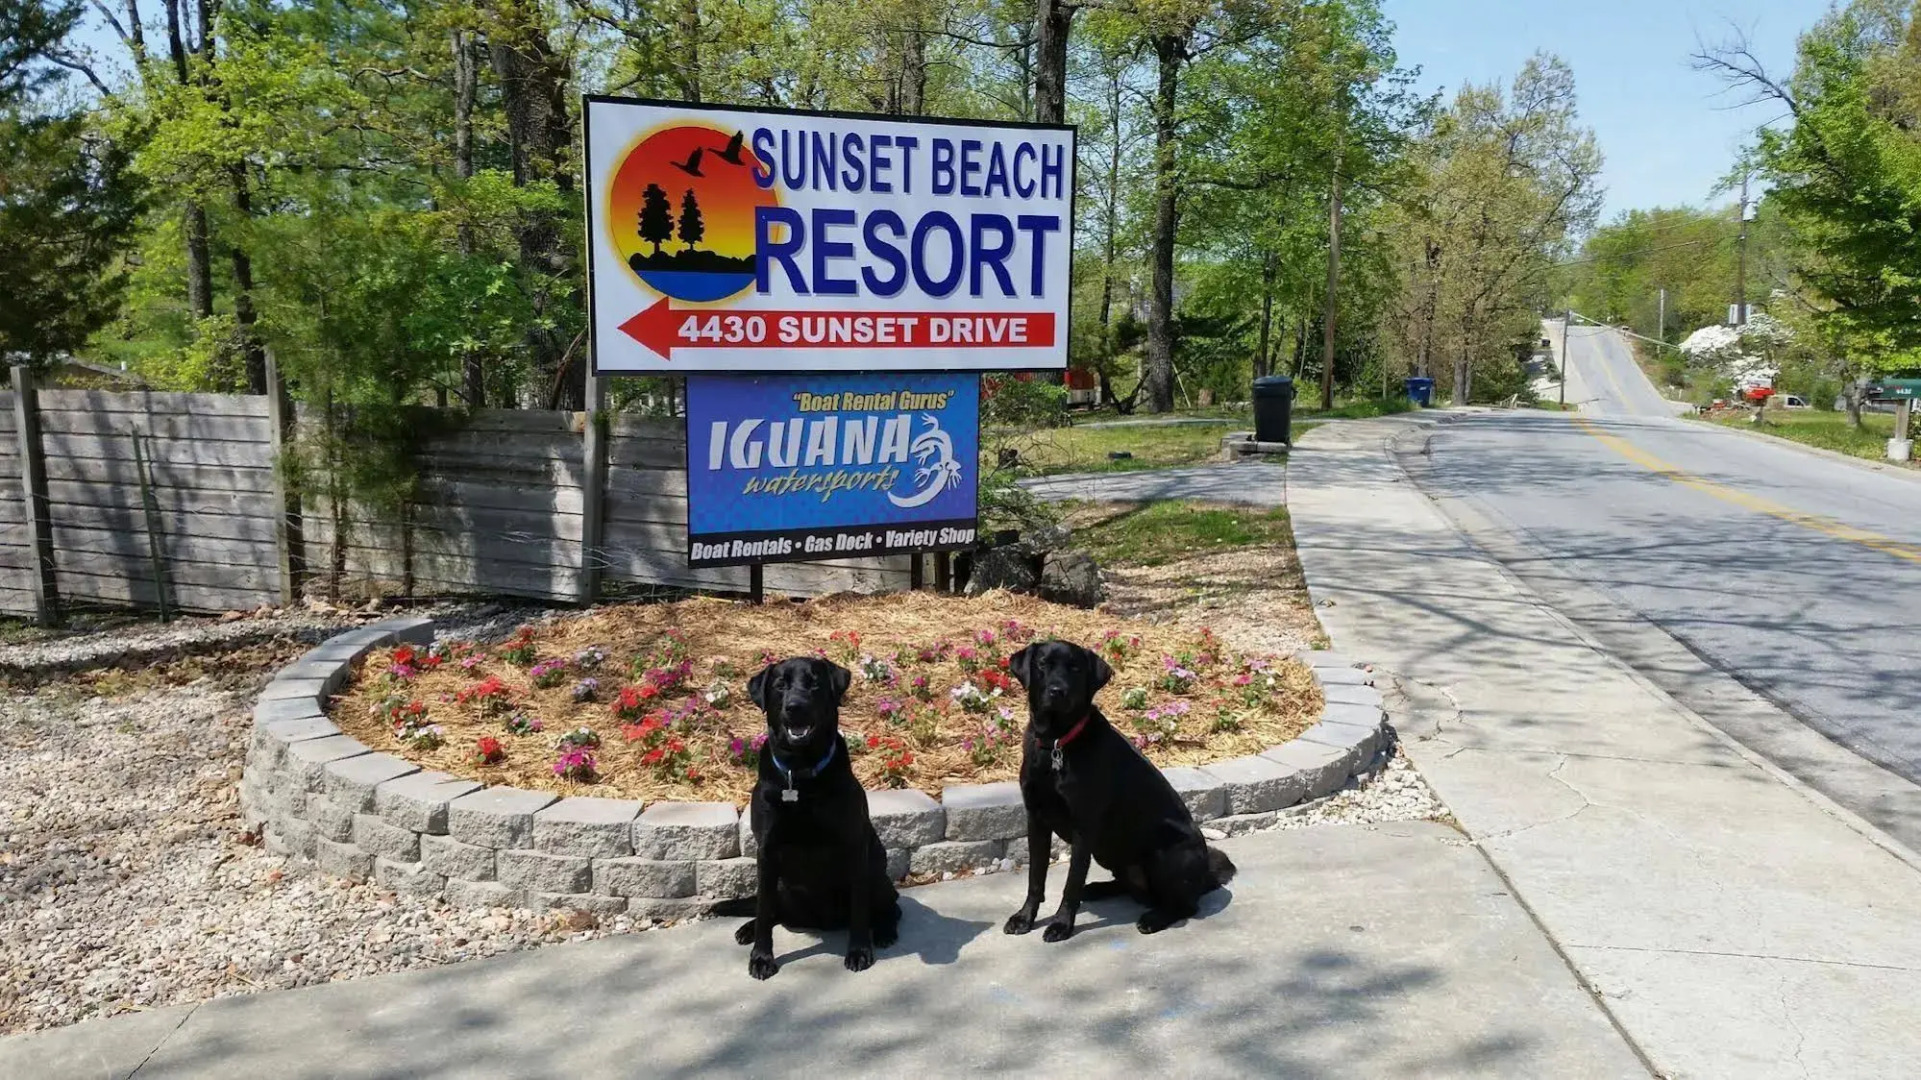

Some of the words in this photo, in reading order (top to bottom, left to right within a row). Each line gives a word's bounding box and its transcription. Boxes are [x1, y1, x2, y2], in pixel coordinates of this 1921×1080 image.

[752, 127, 918, 194] SUNSET
[932, 138, 1064, 200] BEACH
[754, 206, 1060, 298] RESORT
[678, 315, 767, 344] 4430
[778, 316, 917, 344] SUNSET
[929, 317, 1027, 344] DRIVE
[842, 390, 897, 411] Rental
[709, 414, 912, 470] IGUANA
[743, 464, 900, 503] watersports
[690, 542, 730, 560] Boat
[731, 537, 792, 558] Rentals
[804, 535, 834, 553] Gas
[835, 532, 874, 551] Dock
[885, 528, 938, 548] Variety
[939, 527, 976, 545] Shop
